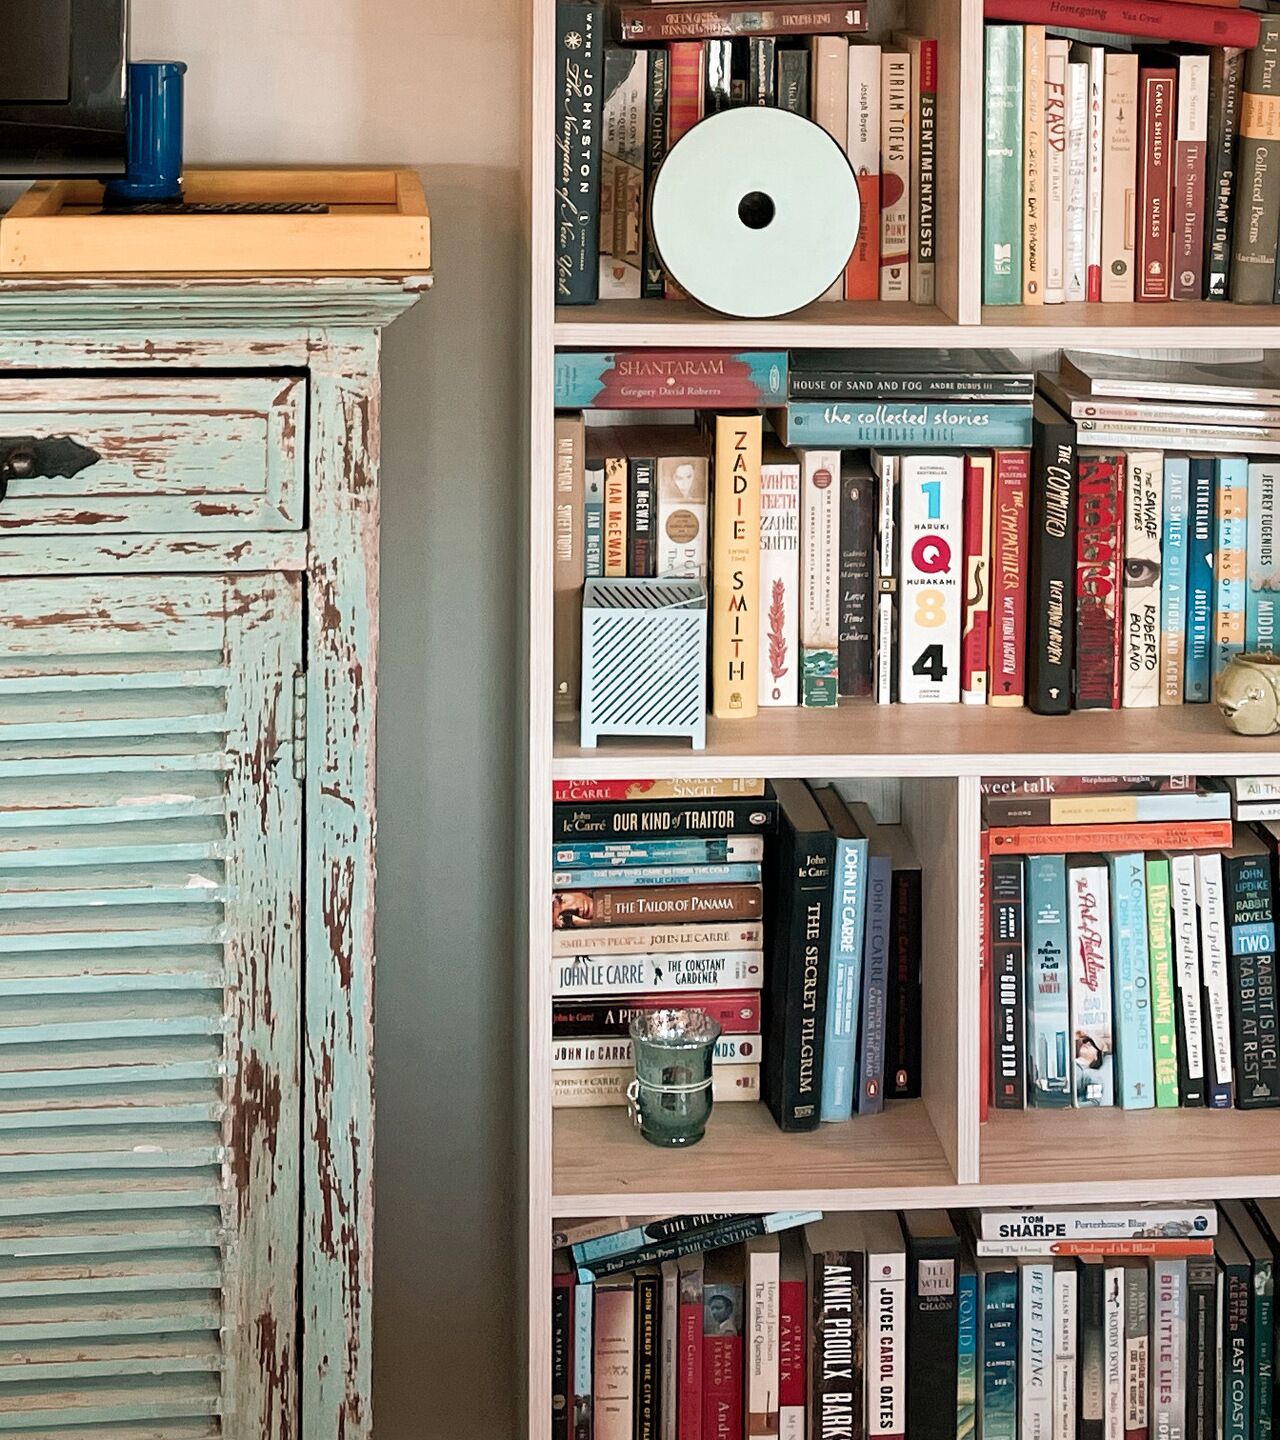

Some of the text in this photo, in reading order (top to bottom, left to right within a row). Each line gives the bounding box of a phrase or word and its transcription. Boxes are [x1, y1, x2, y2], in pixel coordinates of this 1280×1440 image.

[580, 13, 593, 194] WAYNE JOHNSTON
[889, 63, 904, 161] MIRIAM TOEWS
[1044, 81, 1066, 153] FRAUD
[1151, 83, 1163, 238] CAROL SHIELDS UNLESS
[921, 107, 933, 258] SENTIMENTALISTS
[1183, 147, 1198, 257] The Stone Diaries
[1249, 146, 1268, 244] Collected Poems
[1212, 170, 1233, 261] COMPANY TOWN
[619, 360, 724, 376] SHANTARAM
[793, 380, 922, 391] HOUSE OF SAND AND FOG
[621, 388, 657, 398] Gregory
[659, 386, 685, 396] David
[824, 405, 989, 426] the collected stories
[635, 467, 650, 532] IAN McEWAN
[760, 474, 798, 490] WHITE
[761, 493, 797, 509] TEETH
[1133, 467, 1142, 532] DETECTIVES
[607, 483, 623, 568] IAN McEWAN
[760, 512, 797, 532] ZADIE
[1144, 490, 1158, 540] SAVAGE
[1196, 479, 1210, 540] NETHERLAND
[760, 533, 797, 550] SMITH
[1144, 604, 1156, 671] ROBERTO
[613, 810, 735, 831] OUR KIND of TRAITOR
[843, 847, 859, 888] JOHN
[616, 896, 733, 913] THE TAILOR OF PANAMA
[842, 890, 857, 905] LE
[1234, 910, 1272, 923] NOVELS
[1236, 898, 1269, 910] RABBIT
[1238, 935, 1270, 952] TWO
[560, 965, 589, 988] JOHN
[591, 967, 604, 985] LE
[667, 958, 726, 972] THE CONSTANT
[675, 971, 718, 985] GARDENER
[1257, 955, 1274, 1011] RABBIT
[798, 902, 821, 1095] THE SECRET PILGRIM
[1240, 957, 1260, 1081] RABBIT AT REST
[1260, 1033, 1277, 1070] RICH
[999, 1218, 1147, 1238] SHARPE Porterhouse Blue
[1021, 1216, 1044, 1224] TOM
[921, 1277, 952, 1290] WILL
[823, 1264, 852, 1380] ANNIE PROULX
[1160, 1275, 1172, 1405] BIG LITTLE LIES
[880, 1287, 894, 1429] JOYCE CAROL OATES
[1231, 1338, 1245, 1426] EAST COAST
